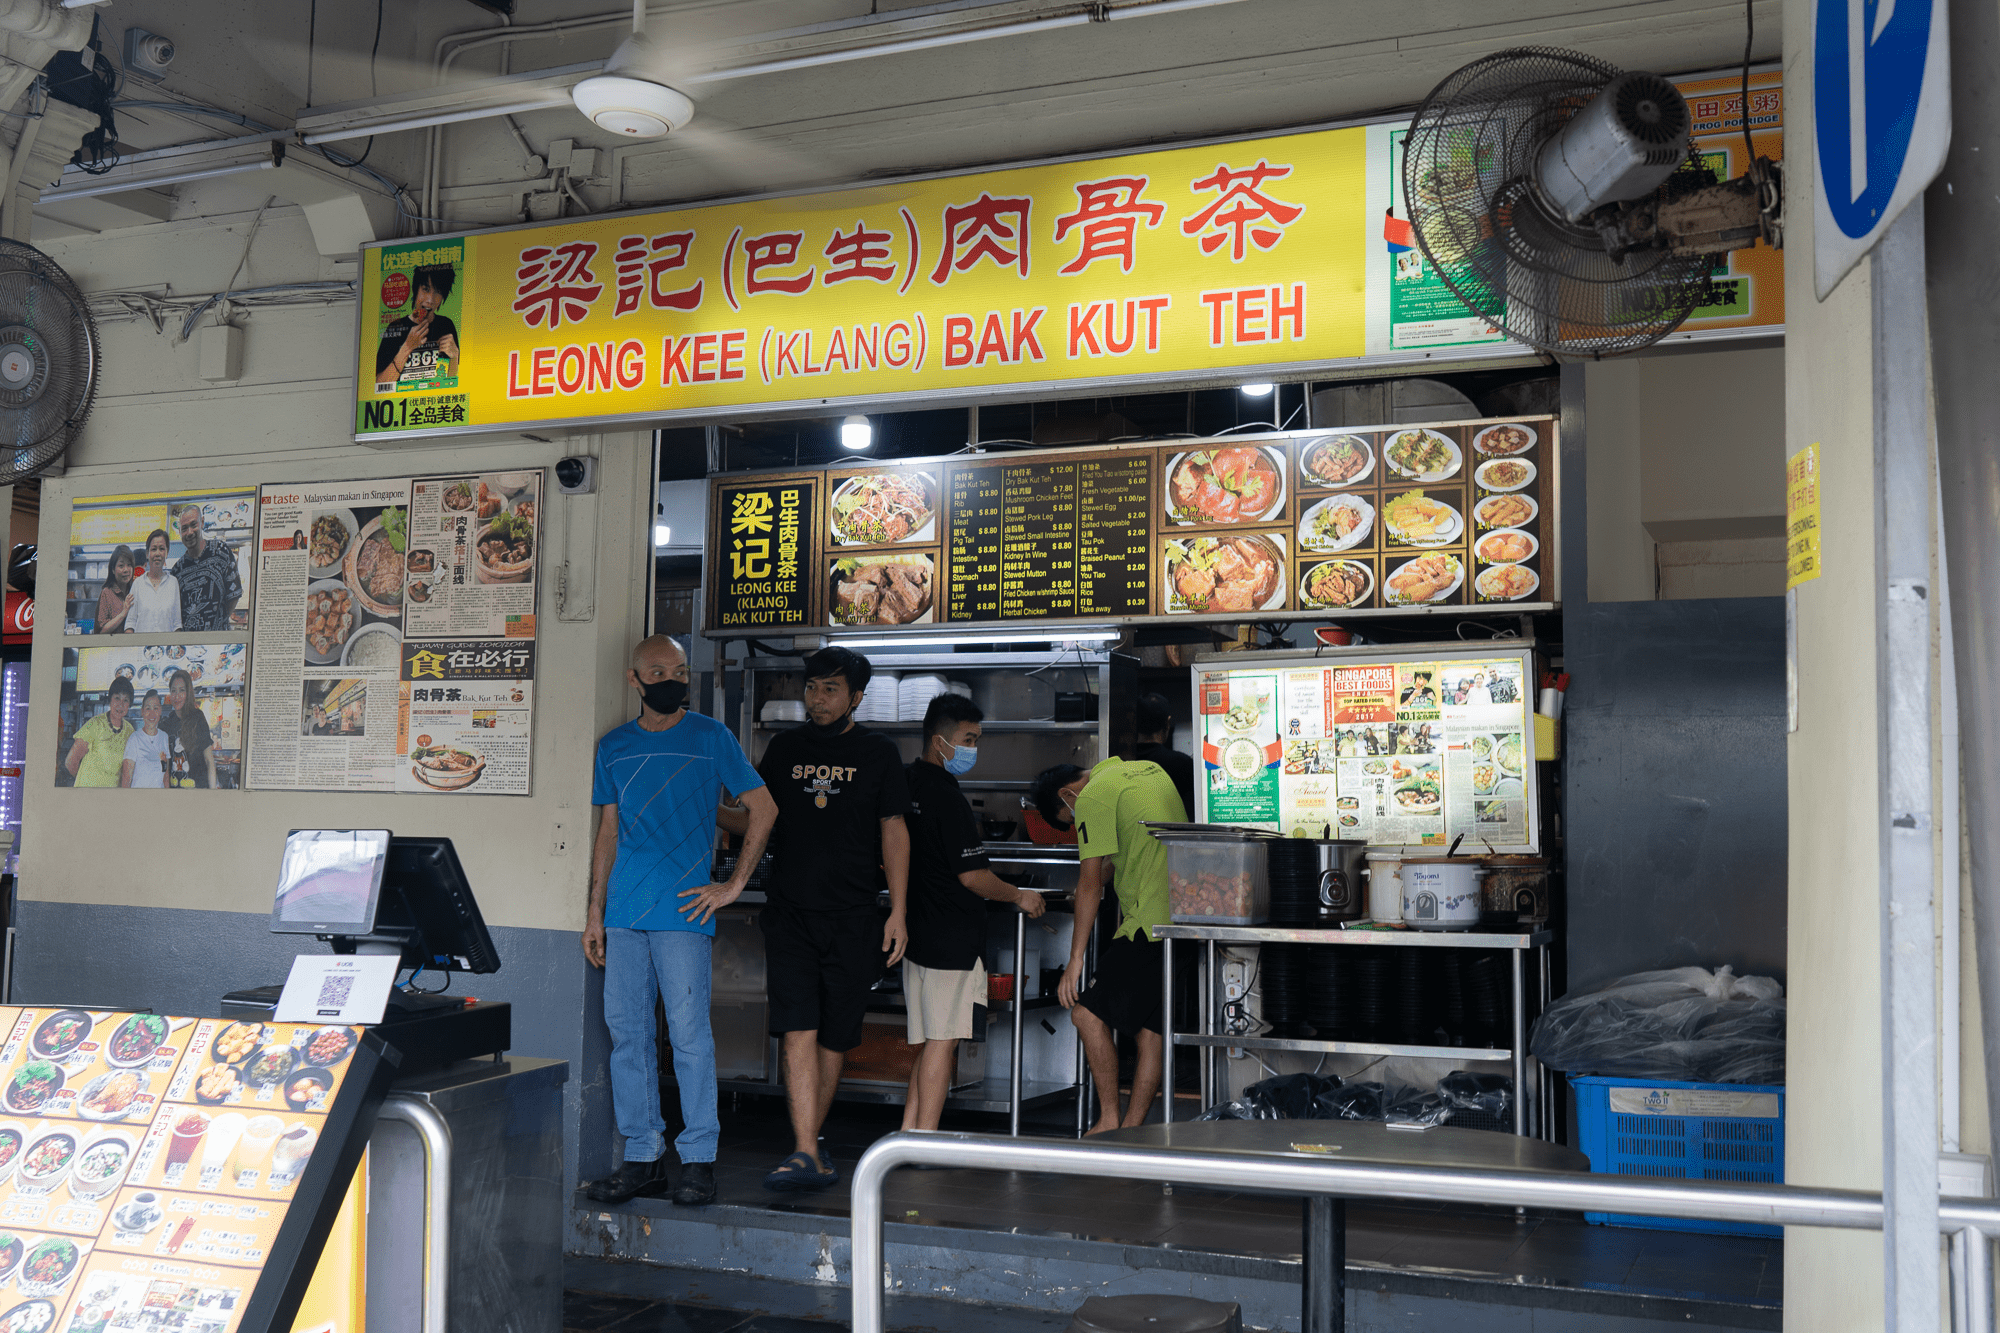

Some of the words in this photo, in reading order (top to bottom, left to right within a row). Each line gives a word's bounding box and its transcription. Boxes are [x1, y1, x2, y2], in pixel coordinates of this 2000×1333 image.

[1693, 121, 1721, 131] FROG
[508, 340, 644, 398] LEONG
[663, 332, 745, 385] KEE
[761, 313, 927, 385] (KLANG)
[945, 310, 1044, 367] BAK
[1069, 297, 1168, 356] KUT
[1202, 285, 1303, 344] TEH
[364, 398, 407, 429] NO.1
[409, 404, 465, 425] 全岛美食
[1006, 478, 1015, 486] Dry
[273, 494, 299, 504] taste
[304, 494, 337, 505] Malaysian
[338, 492, 361, 501] makan
[362, 491, 369, 500] in
[371, 490, 404, 501] Singapore
[1101, 520, 1130, 528] Vegetable
[730, 492, 774, 580] 梁记
[777, 489, 800, 579] 巴生肉骨茶
[1004, 571, 1025, 579] Stewed
[731, 582, 771, 595] LEONG
[776, 581, 796, 592] KEE
[737, 595, 788, 610] (KLANG)
[723, 612, 746, 624] BAK
[751, 611, 773, 623] KUT
[779, 610, 802, 622] TEH
[406, 650, 529, 679] 食在必行
[1335, 669, 1392, 680] SINGAPORE
[1336, 681, 1358, 690] BEST
[1362, 680, 1390, 689] FOODS
[414, 688, 461, 702] 肉骨茶
[1397, 712, 1415, 720] NO.1
[792, 765, 857, 781] SPORT
[1078, 822, 1088, 844] 1
[1643, 1095, 1661, 1105] Two
